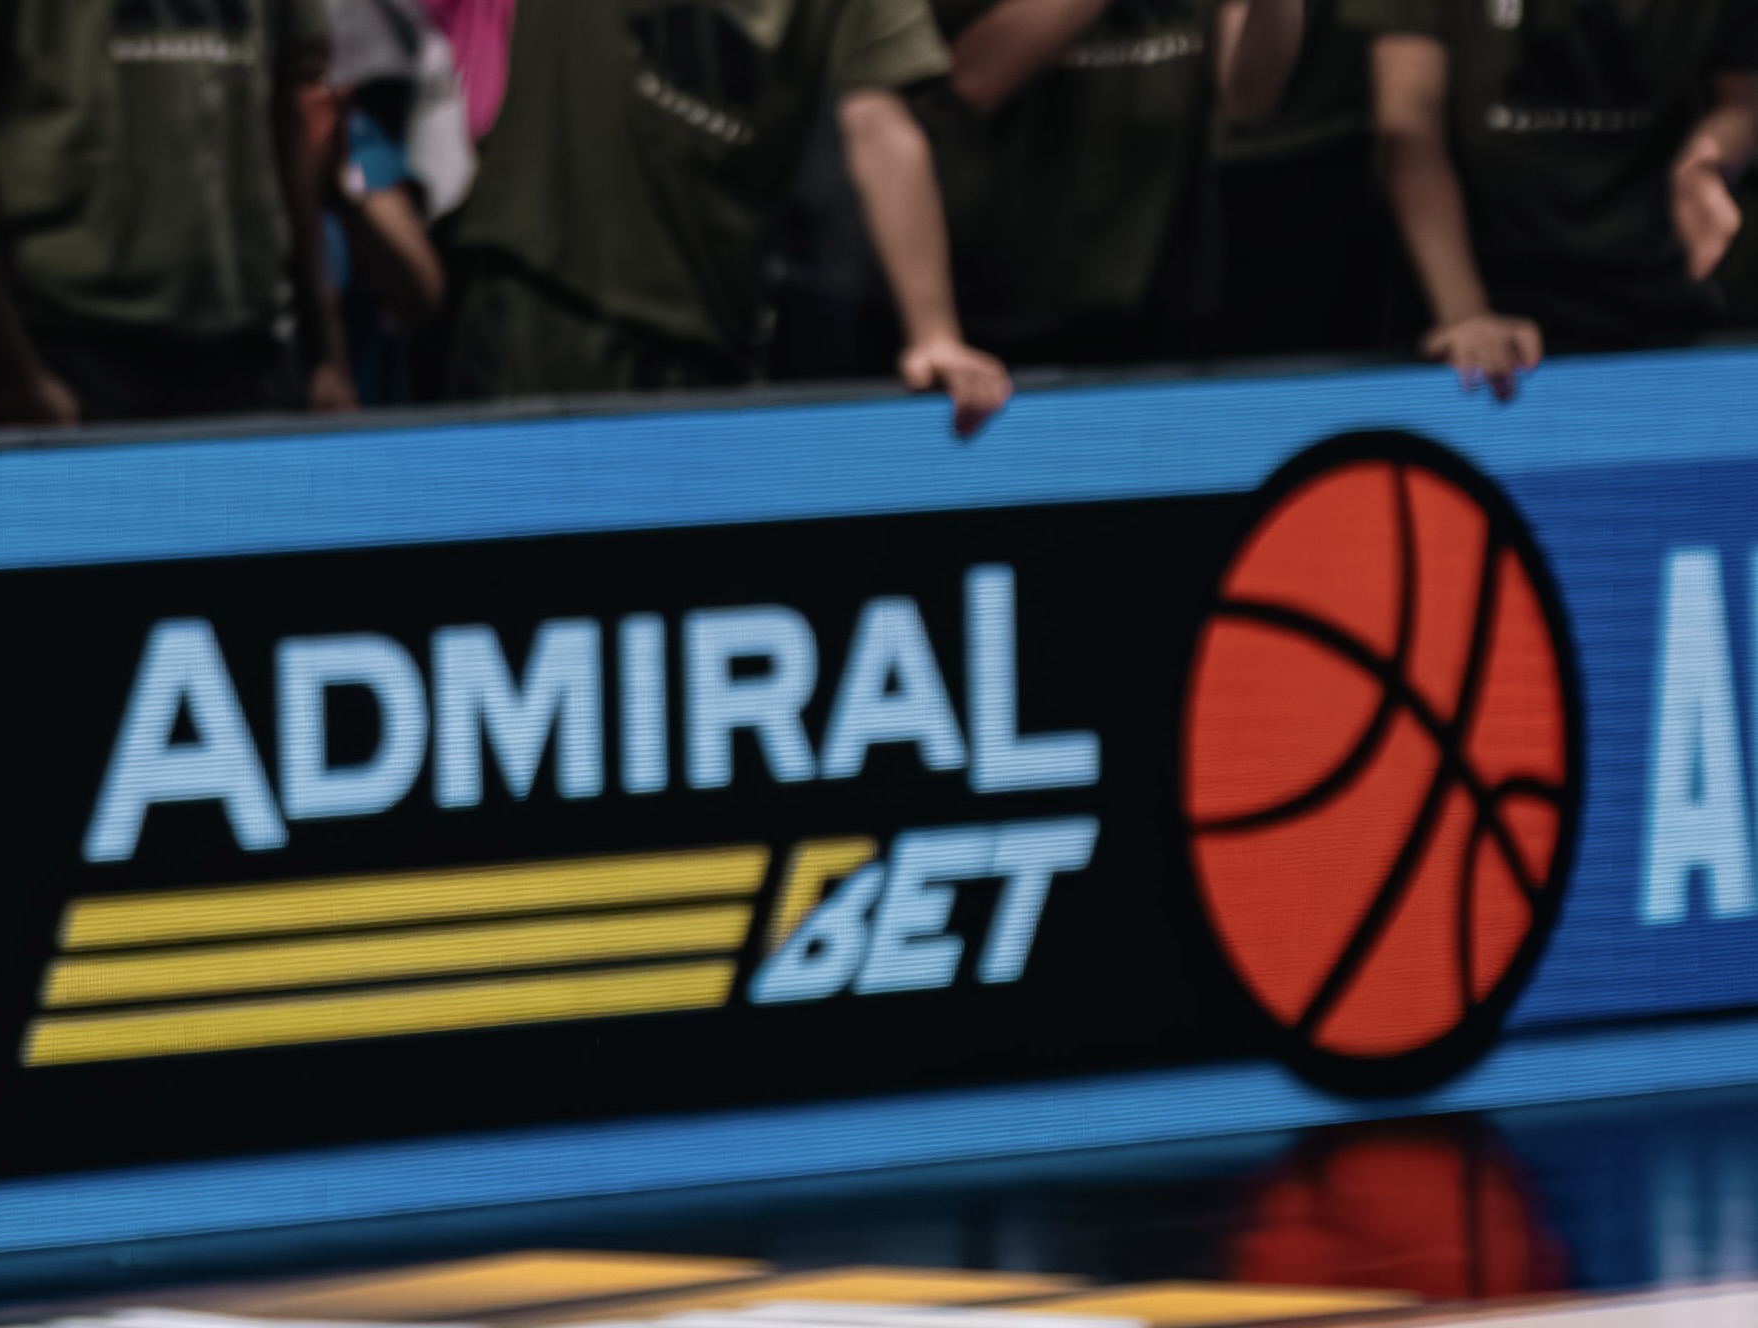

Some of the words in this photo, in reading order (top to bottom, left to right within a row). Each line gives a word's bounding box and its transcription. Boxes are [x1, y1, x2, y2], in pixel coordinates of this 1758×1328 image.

[83, 562, 1101, 863] ADMIRAL
[1640, 545, 1758, 924] A
[747, 816, 1101, 1006] BET
